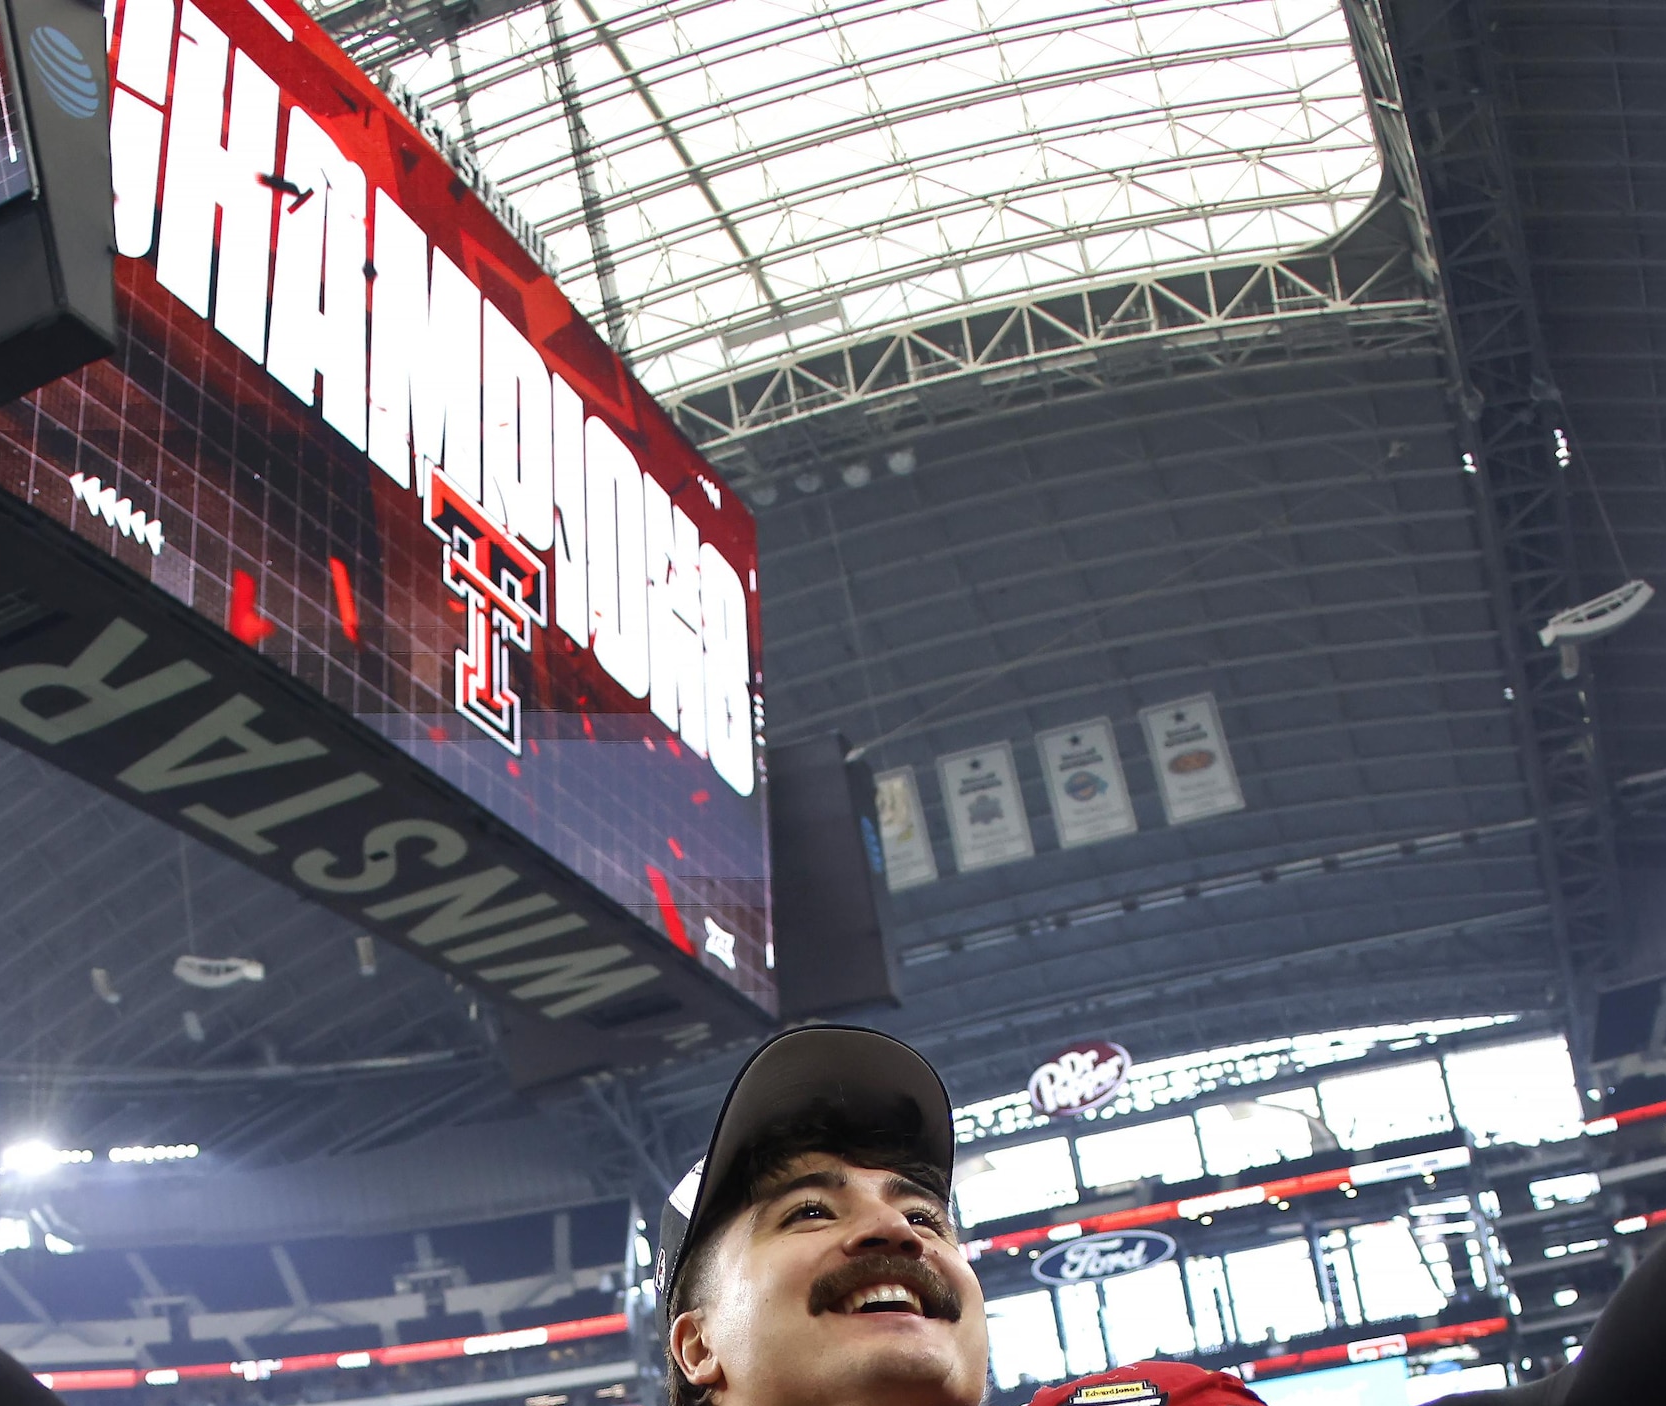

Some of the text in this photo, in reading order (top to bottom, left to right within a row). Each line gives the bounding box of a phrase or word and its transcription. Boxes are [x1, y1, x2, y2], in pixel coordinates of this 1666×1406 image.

[106, 0, 756, 797] CHAMPIONS
[1032, 1054, 1123, 1113] Pepper
[1059, 1049, 1100, 1079] Dr
[1060, 1237, 1149, 1280] Ford
